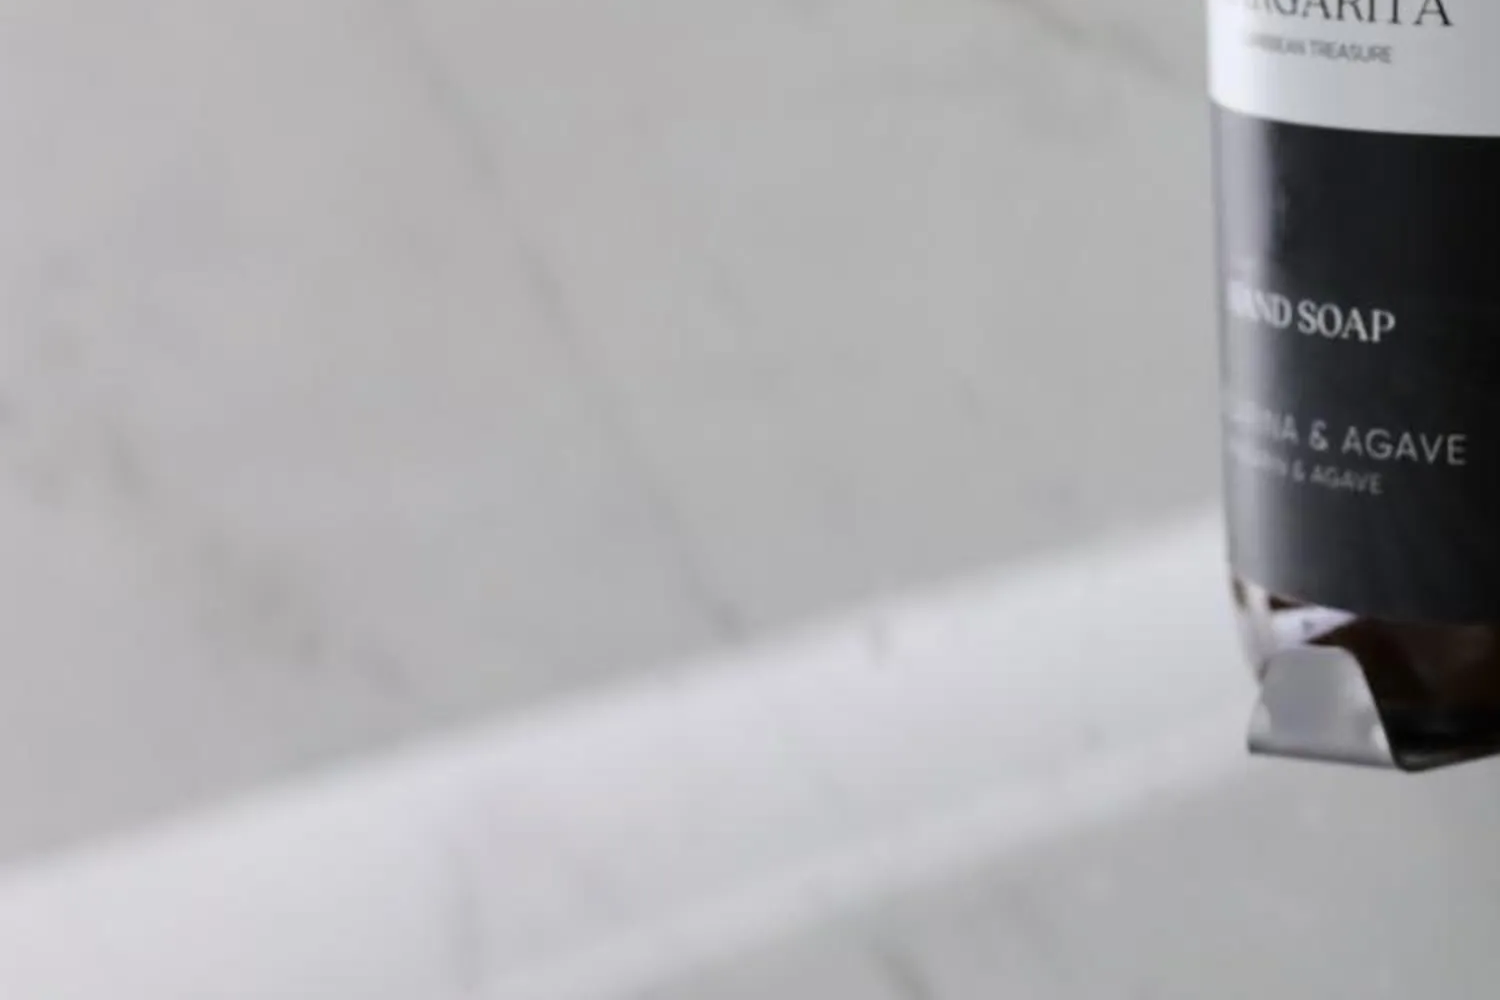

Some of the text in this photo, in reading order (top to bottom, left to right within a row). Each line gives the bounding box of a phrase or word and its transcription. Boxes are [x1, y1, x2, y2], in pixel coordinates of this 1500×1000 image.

[1297, 298, 1396, 343] SOAP
[1308, 419, 1330, 451] &
[1341, 425, 1468, 466] AGAVE
[1310, 463, 1384, 495] AGAVE
